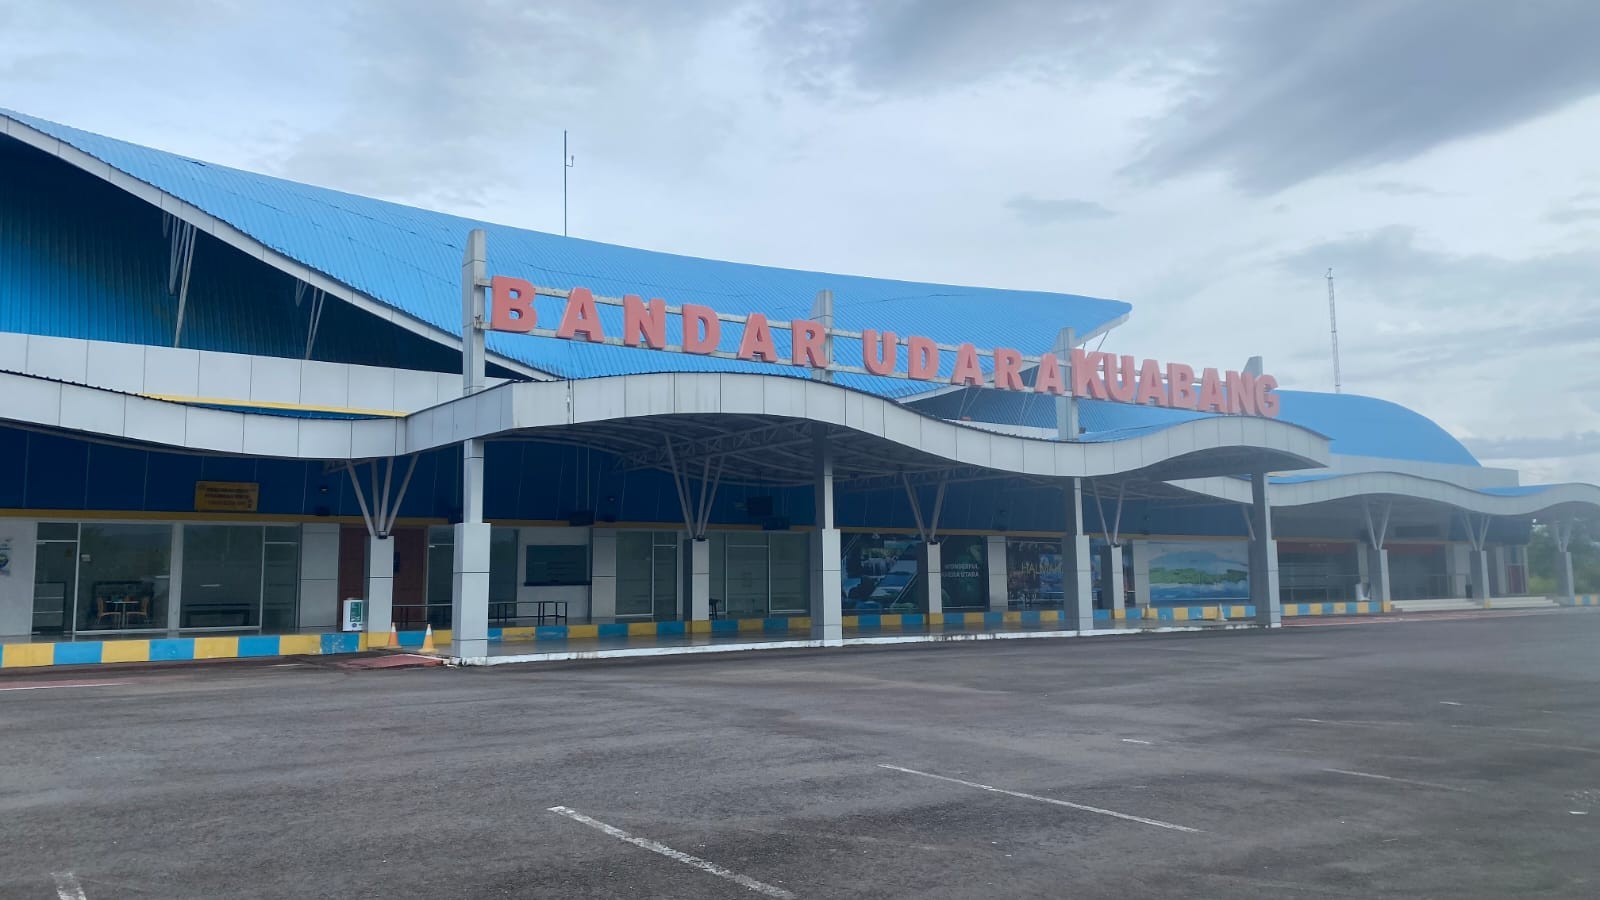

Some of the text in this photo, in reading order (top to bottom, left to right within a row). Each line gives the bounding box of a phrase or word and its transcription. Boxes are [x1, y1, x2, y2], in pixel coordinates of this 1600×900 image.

[491, 275, 1280, 417] BANDAR UDARA KUABANG
